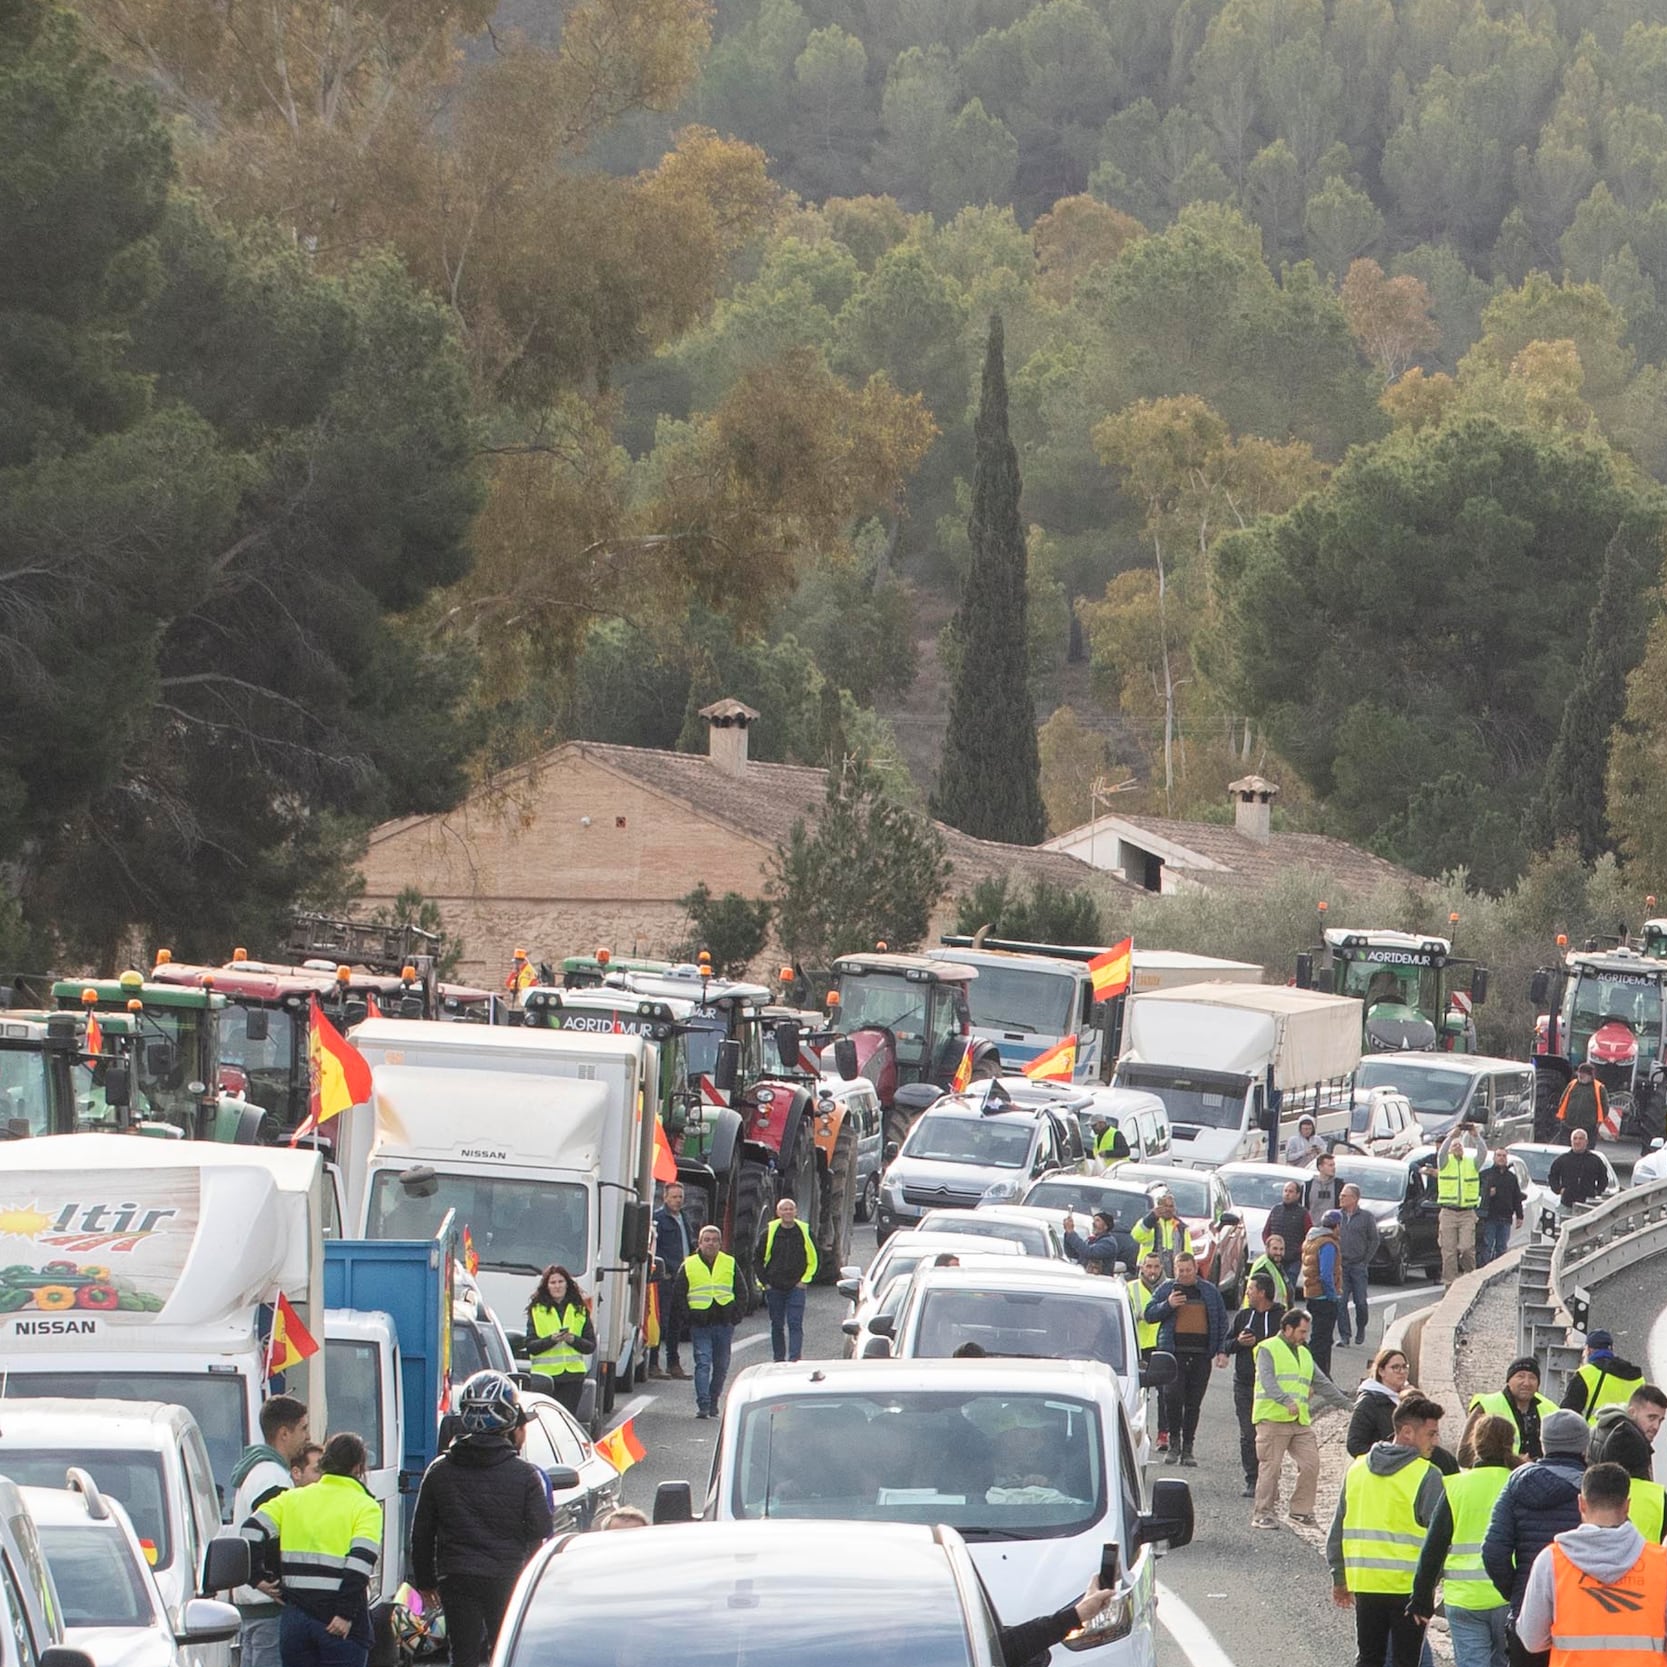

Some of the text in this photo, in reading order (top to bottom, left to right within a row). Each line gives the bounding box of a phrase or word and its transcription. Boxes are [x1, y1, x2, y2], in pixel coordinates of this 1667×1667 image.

[1368, 951, 1431, 966] AGRIDEMUR
[1597, 972, 1657, 987] AGRIDEMUR
[563, 1015, 653, 1037] AGRIDMUR
[461, 1149, 507, 1160] NISSAN
[15, 1320, 96, 1335] NISSAN
